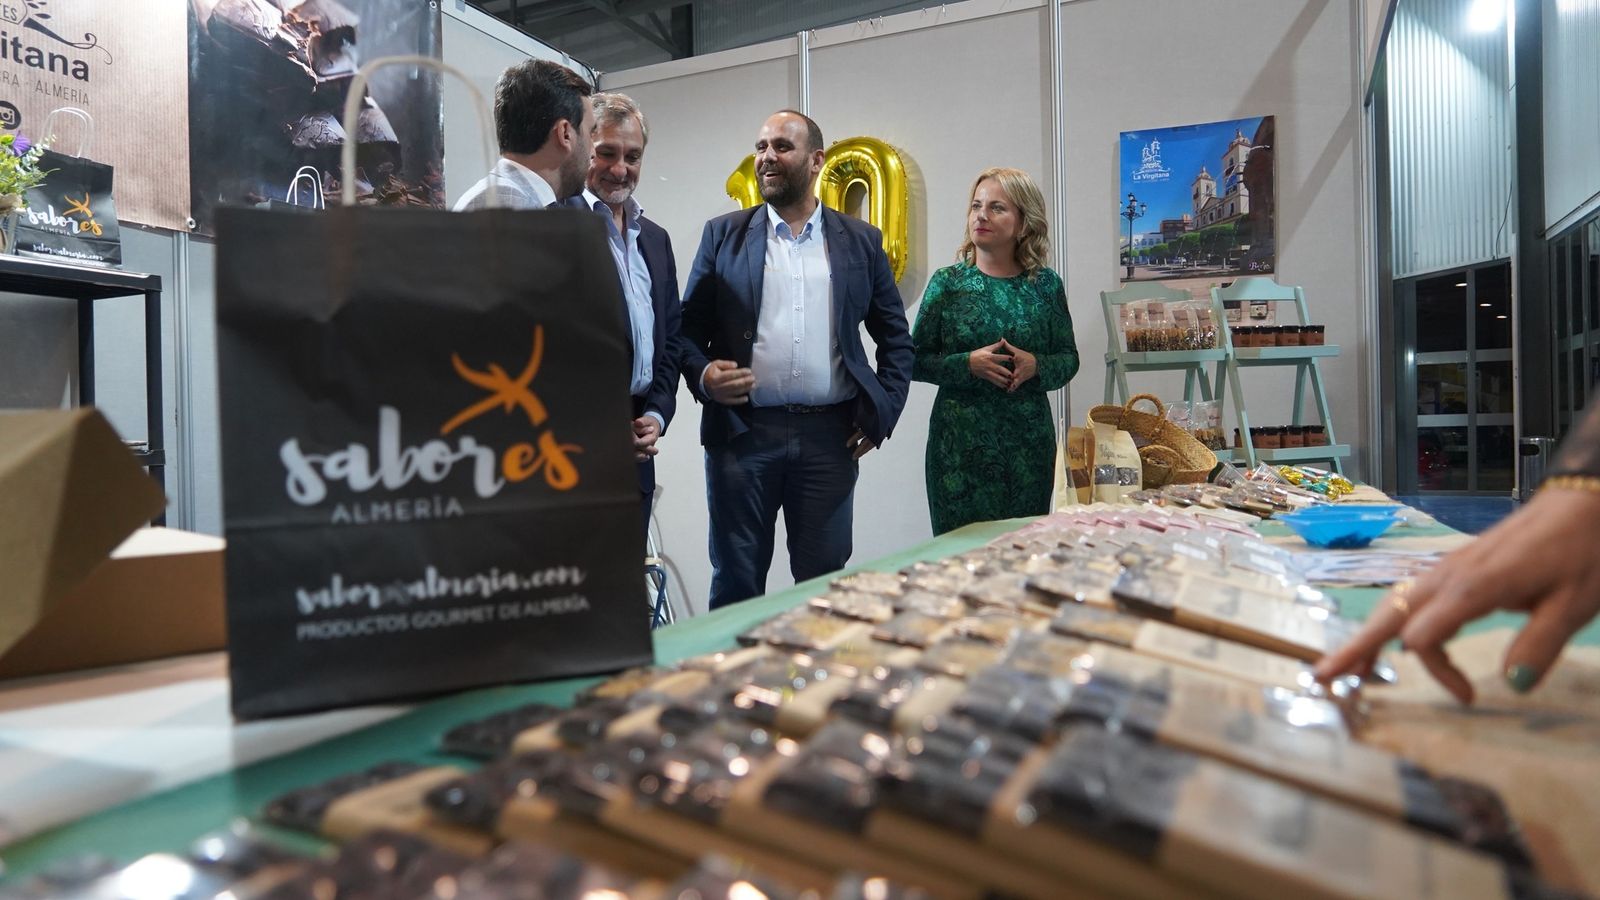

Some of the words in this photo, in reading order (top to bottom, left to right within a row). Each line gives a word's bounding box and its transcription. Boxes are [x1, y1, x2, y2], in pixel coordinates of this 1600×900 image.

[35, 80, 89, 105] ALMERÍA
[1142, 172, 1170, 180] Virgitana
[280, 405, 584, 506] sabores
[297, 613, 409, 640] PRODUCTOS
[411, 604, 495, 630] GOURMET
[499, 602, 520, 619] DE
